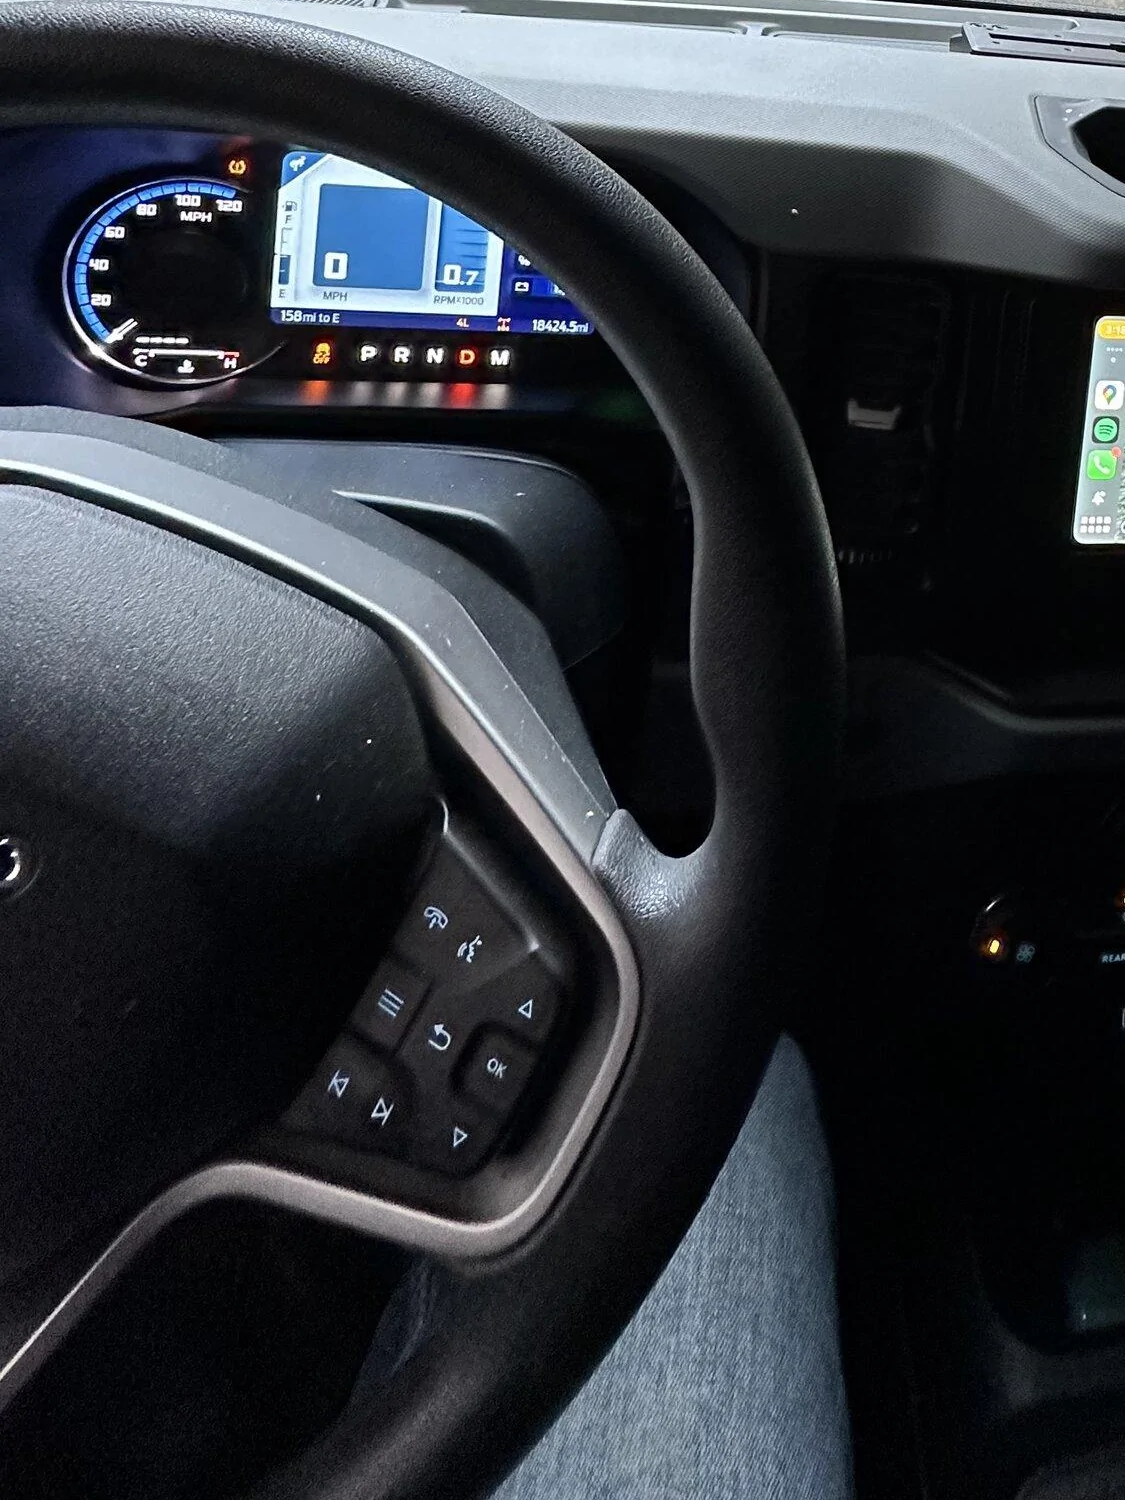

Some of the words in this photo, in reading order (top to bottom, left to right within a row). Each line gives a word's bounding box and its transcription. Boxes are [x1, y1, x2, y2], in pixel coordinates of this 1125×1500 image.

[174, 194, 201, 207] 100
[216, 199, 243, 212] 120
[136, 203, 157, 216] 80
[180, 211, 213, 222] MPH
[104, 226, 125, 238] 60
[88, 258, 109, 271] 40
[323, 251, 349, 280] 0
[443, 264, 480, 286] 0.7
[90, 293, 112, 306] 20
[323, 291, 348, 301] MPH
[318, 313, 331, 323] to
[332, 313, 340, 324] E
[456, 318, 470, 328] 4L
[134, 355, 148, 367] C
[223, 357, 237, 368] H
[360, 346, 377, 362] P
[394, 347, 409, 363] R
[427, 348, 444, 364] N
[459, 349, 475, 365] D
[490, 350, 511, 366] M
[486, 1057, 508, 1079] OK
